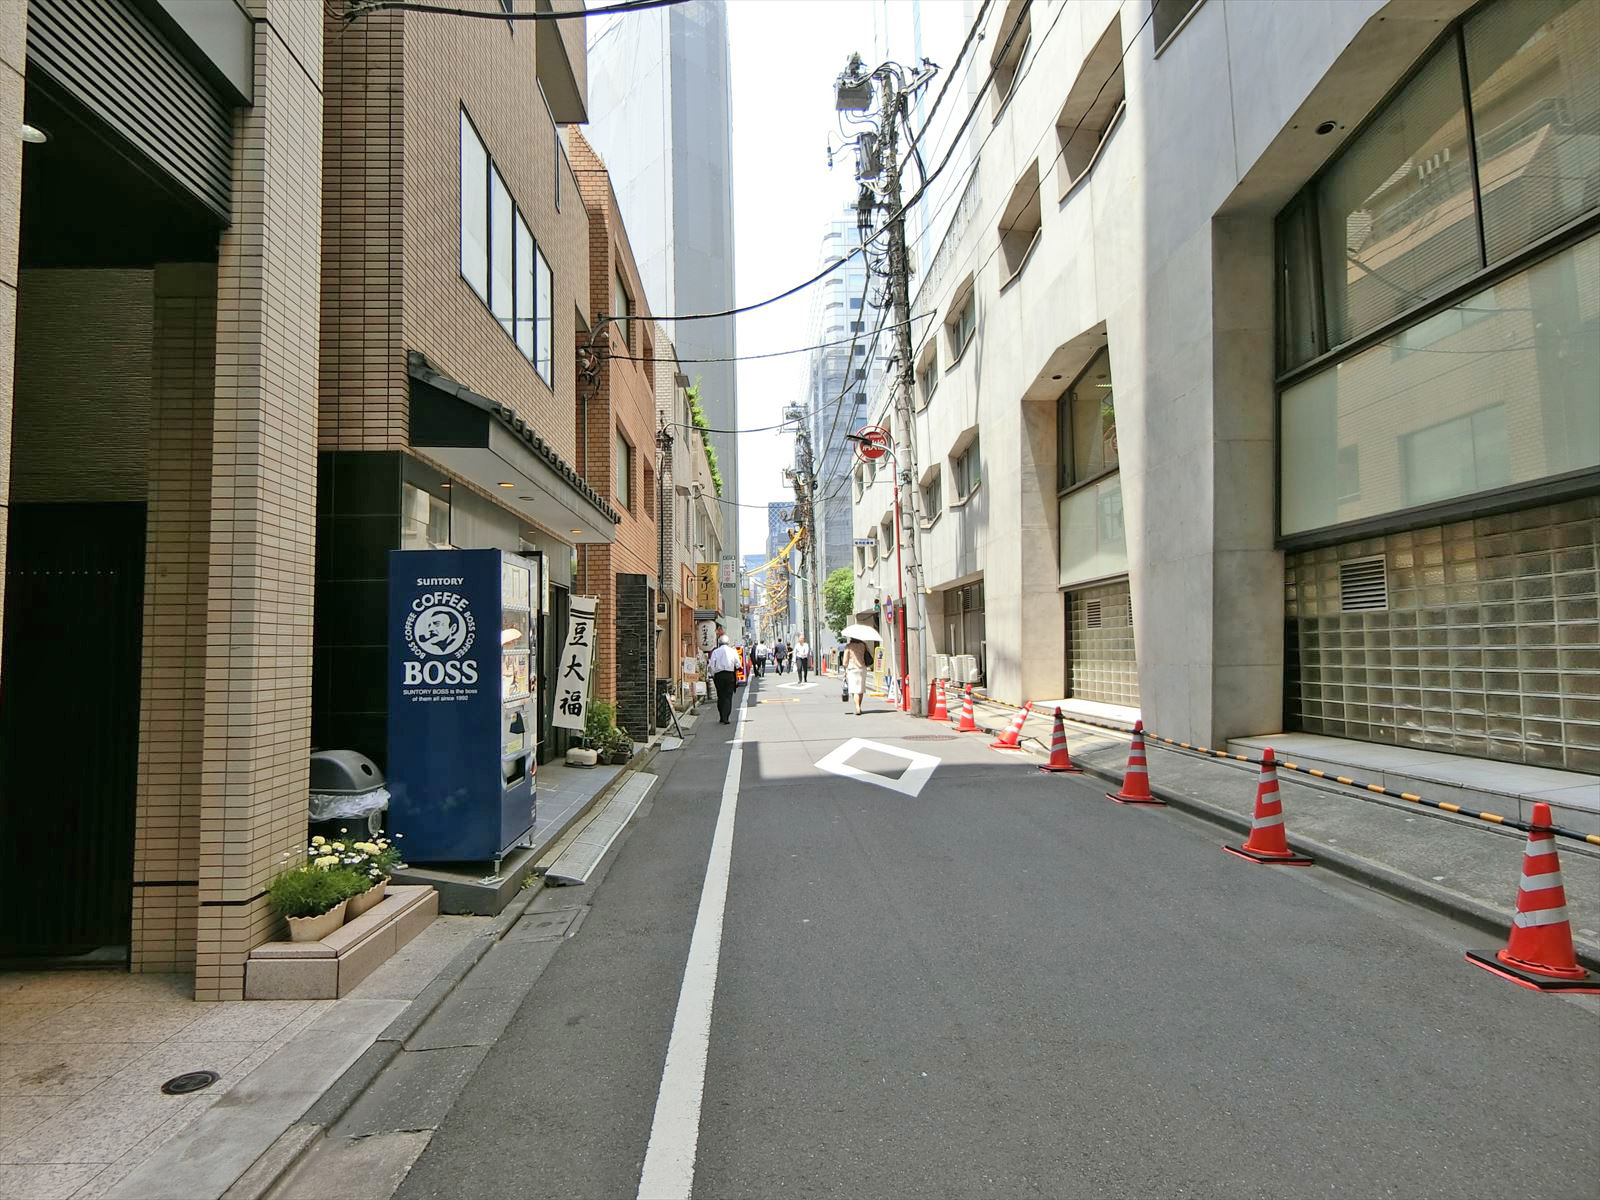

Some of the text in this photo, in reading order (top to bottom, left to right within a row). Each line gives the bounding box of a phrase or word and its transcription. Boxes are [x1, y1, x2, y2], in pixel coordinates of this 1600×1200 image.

[417, 577, 464, 586] SUNTORY
[412, 591, 470, 612] COFFEE
[405, 612, 426, 659] BOSS COFFEE
[454, 611, 476, 659] BOSS COFFEE
[403, 660, 478, 685] BOSS
[559, 621, 588, 717] 豆大福
